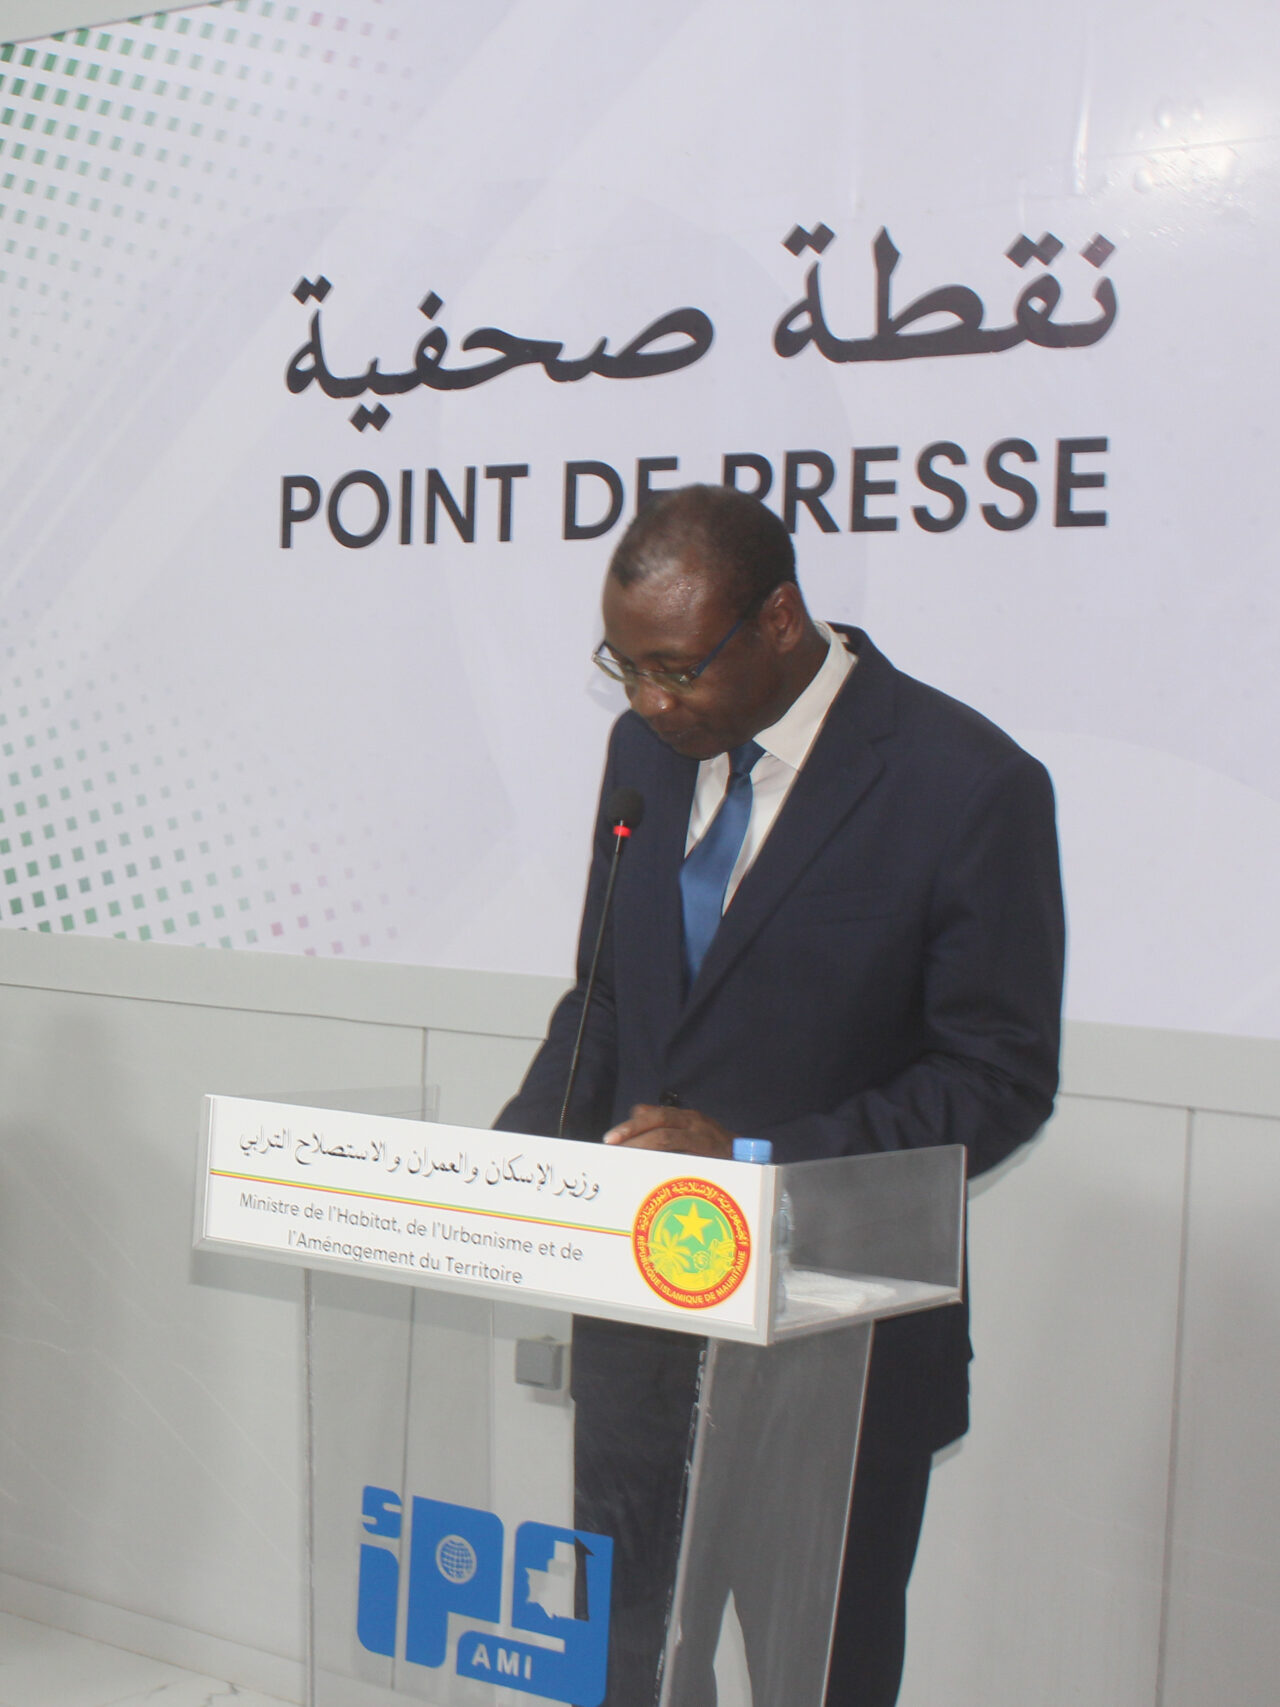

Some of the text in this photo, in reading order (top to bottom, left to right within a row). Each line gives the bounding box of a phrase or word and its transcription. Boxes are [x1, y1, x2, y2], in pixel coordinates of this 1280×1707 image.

[286, 221, 1117, 432] نقطة صحفية
[280, 463, 528, 549] POINT
[721, 436, 1110, 534] PRESSE
[239, 1125, 291, 1157] الترابي
[485, 1154, 553, 1192] الإسكان
[552, 1172, 600, 1201] وزير
[240, 1192, 300, 1216] Ministre
[304, 1203, 324, 1220] de
[406, 1218, 427, 1236] de
[432, 1221, 533, 1253] l'Urbanisme
[538, 1241, 556, 1257] et
[560, 1242, 583, 1261] de
[288, 1229, 523, 1284] l'Aménagement du Territoire
[472, 1644, 532, 1680] AMI
